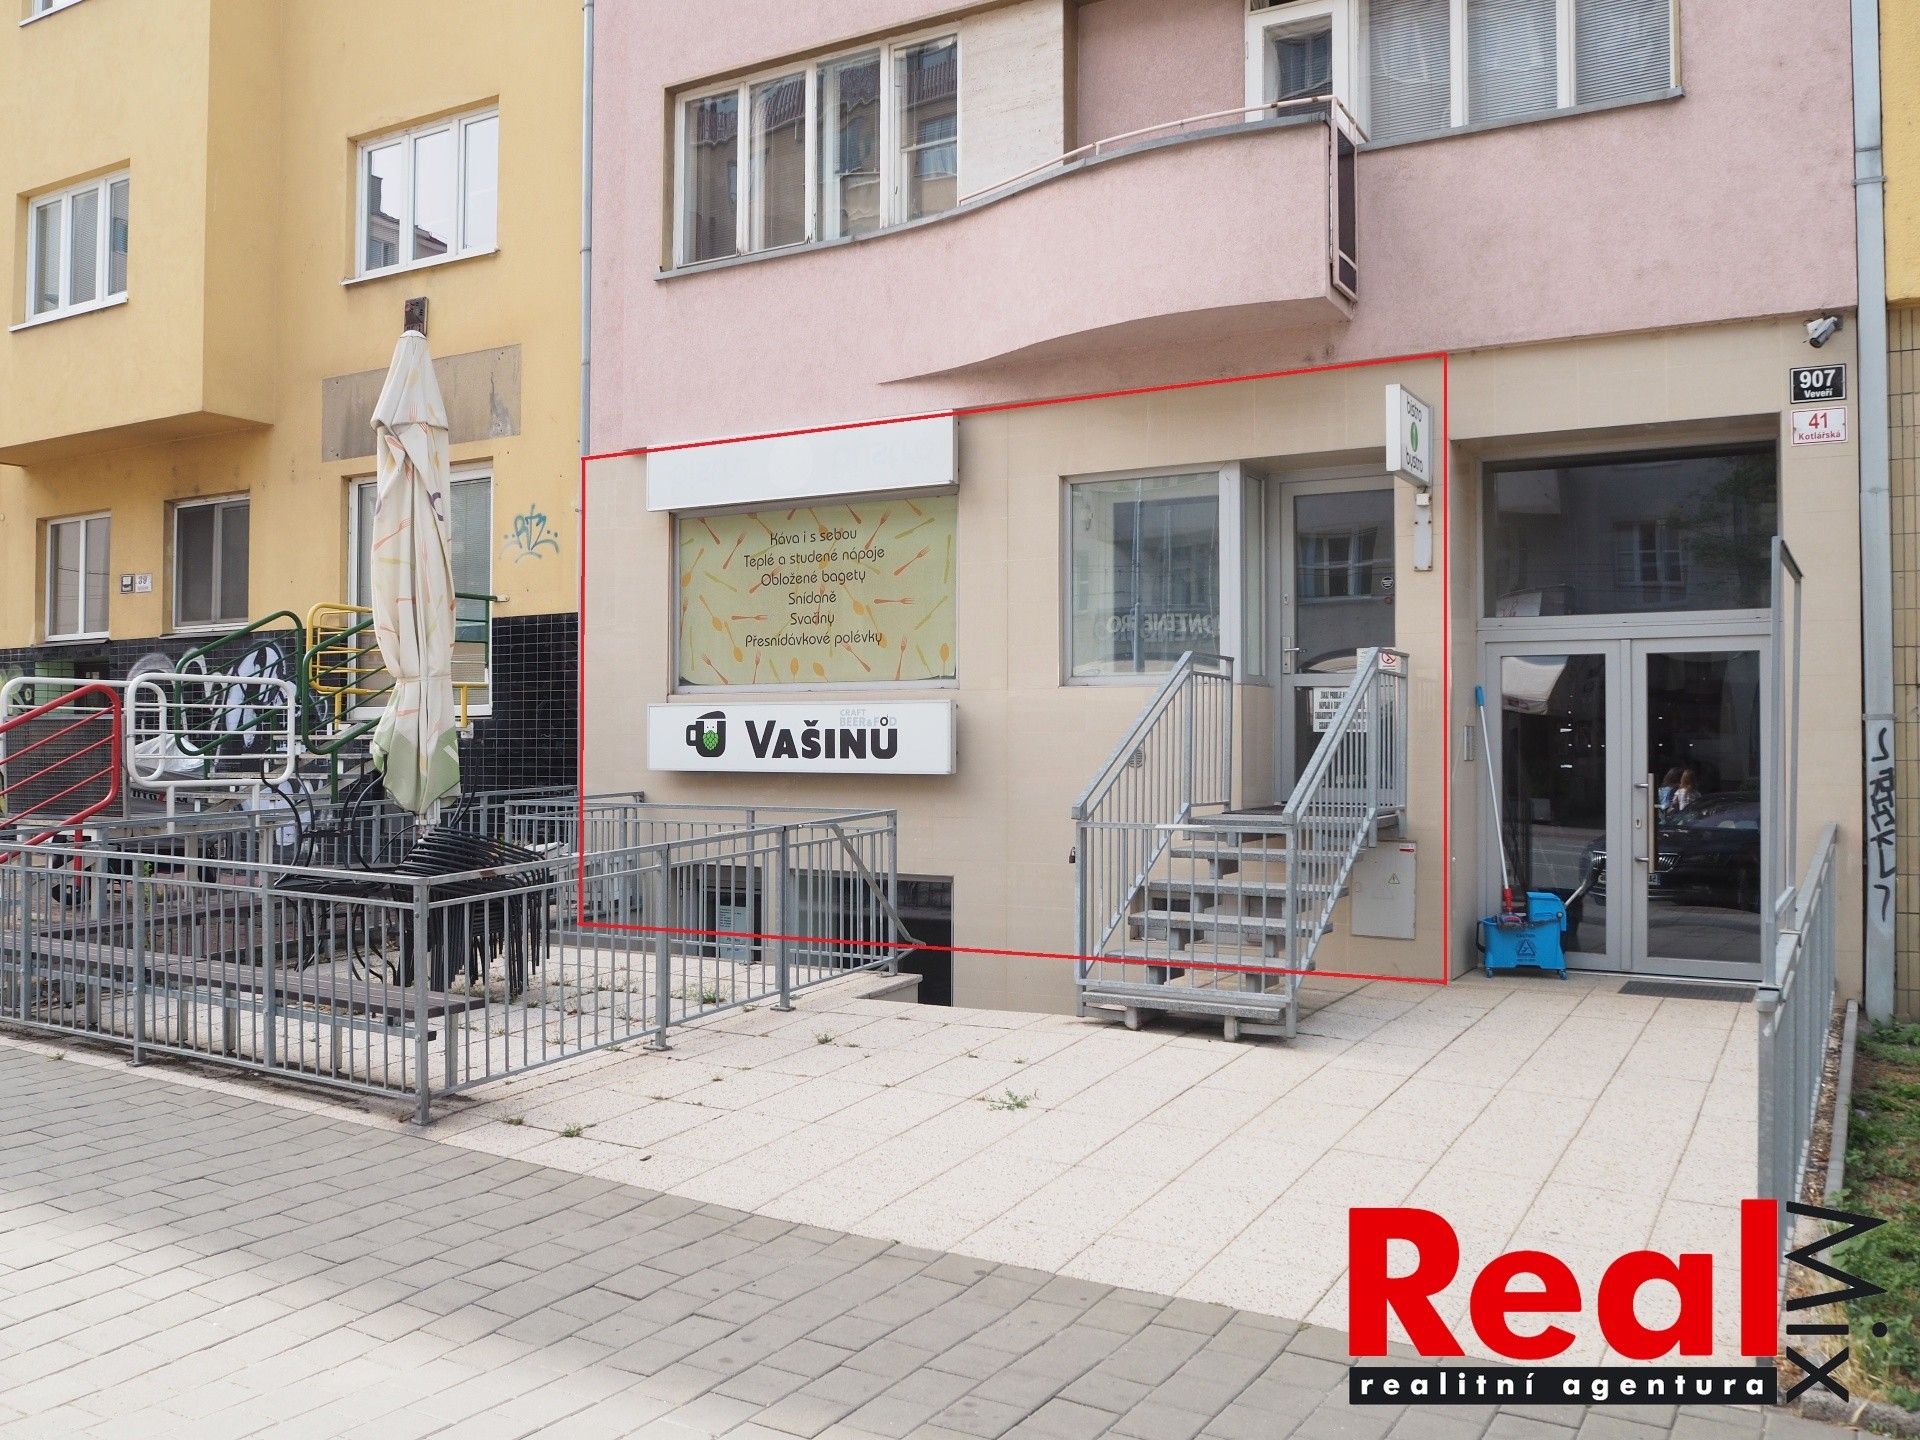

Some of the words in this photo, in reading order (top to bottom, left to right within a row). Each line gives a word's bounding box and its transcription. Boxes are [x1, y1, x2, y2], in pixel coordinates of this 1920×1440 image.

[1799, 369, 1836, 389] 907
[1804, 388, 1833, 398] Veveří
[1808, 412, 1828, 429] 41
[1798, 430, 1841, 441] Kotlářská
[770, 531, 800, 545] Káva
[803, 531, 807, 543] i
[810, 533, 817, 543] s
[819, 527, 857, 542] sebou
[744, 553, 775, 570] Teplé
[778, 555, 786, 565] a
[789, 548, 838, 565] studené
[842, 546, 885, 563] nápoje
[761, 570, 818, 586] Obložené
[821, 569, 866, 586] bagety
[788, 590, 837, 606] Snídaně
[745, 630, 831, 647] Přesnídávkové
[834, 629, 883, 648] polévky
[839, 708, 867, 717] CRAFT
